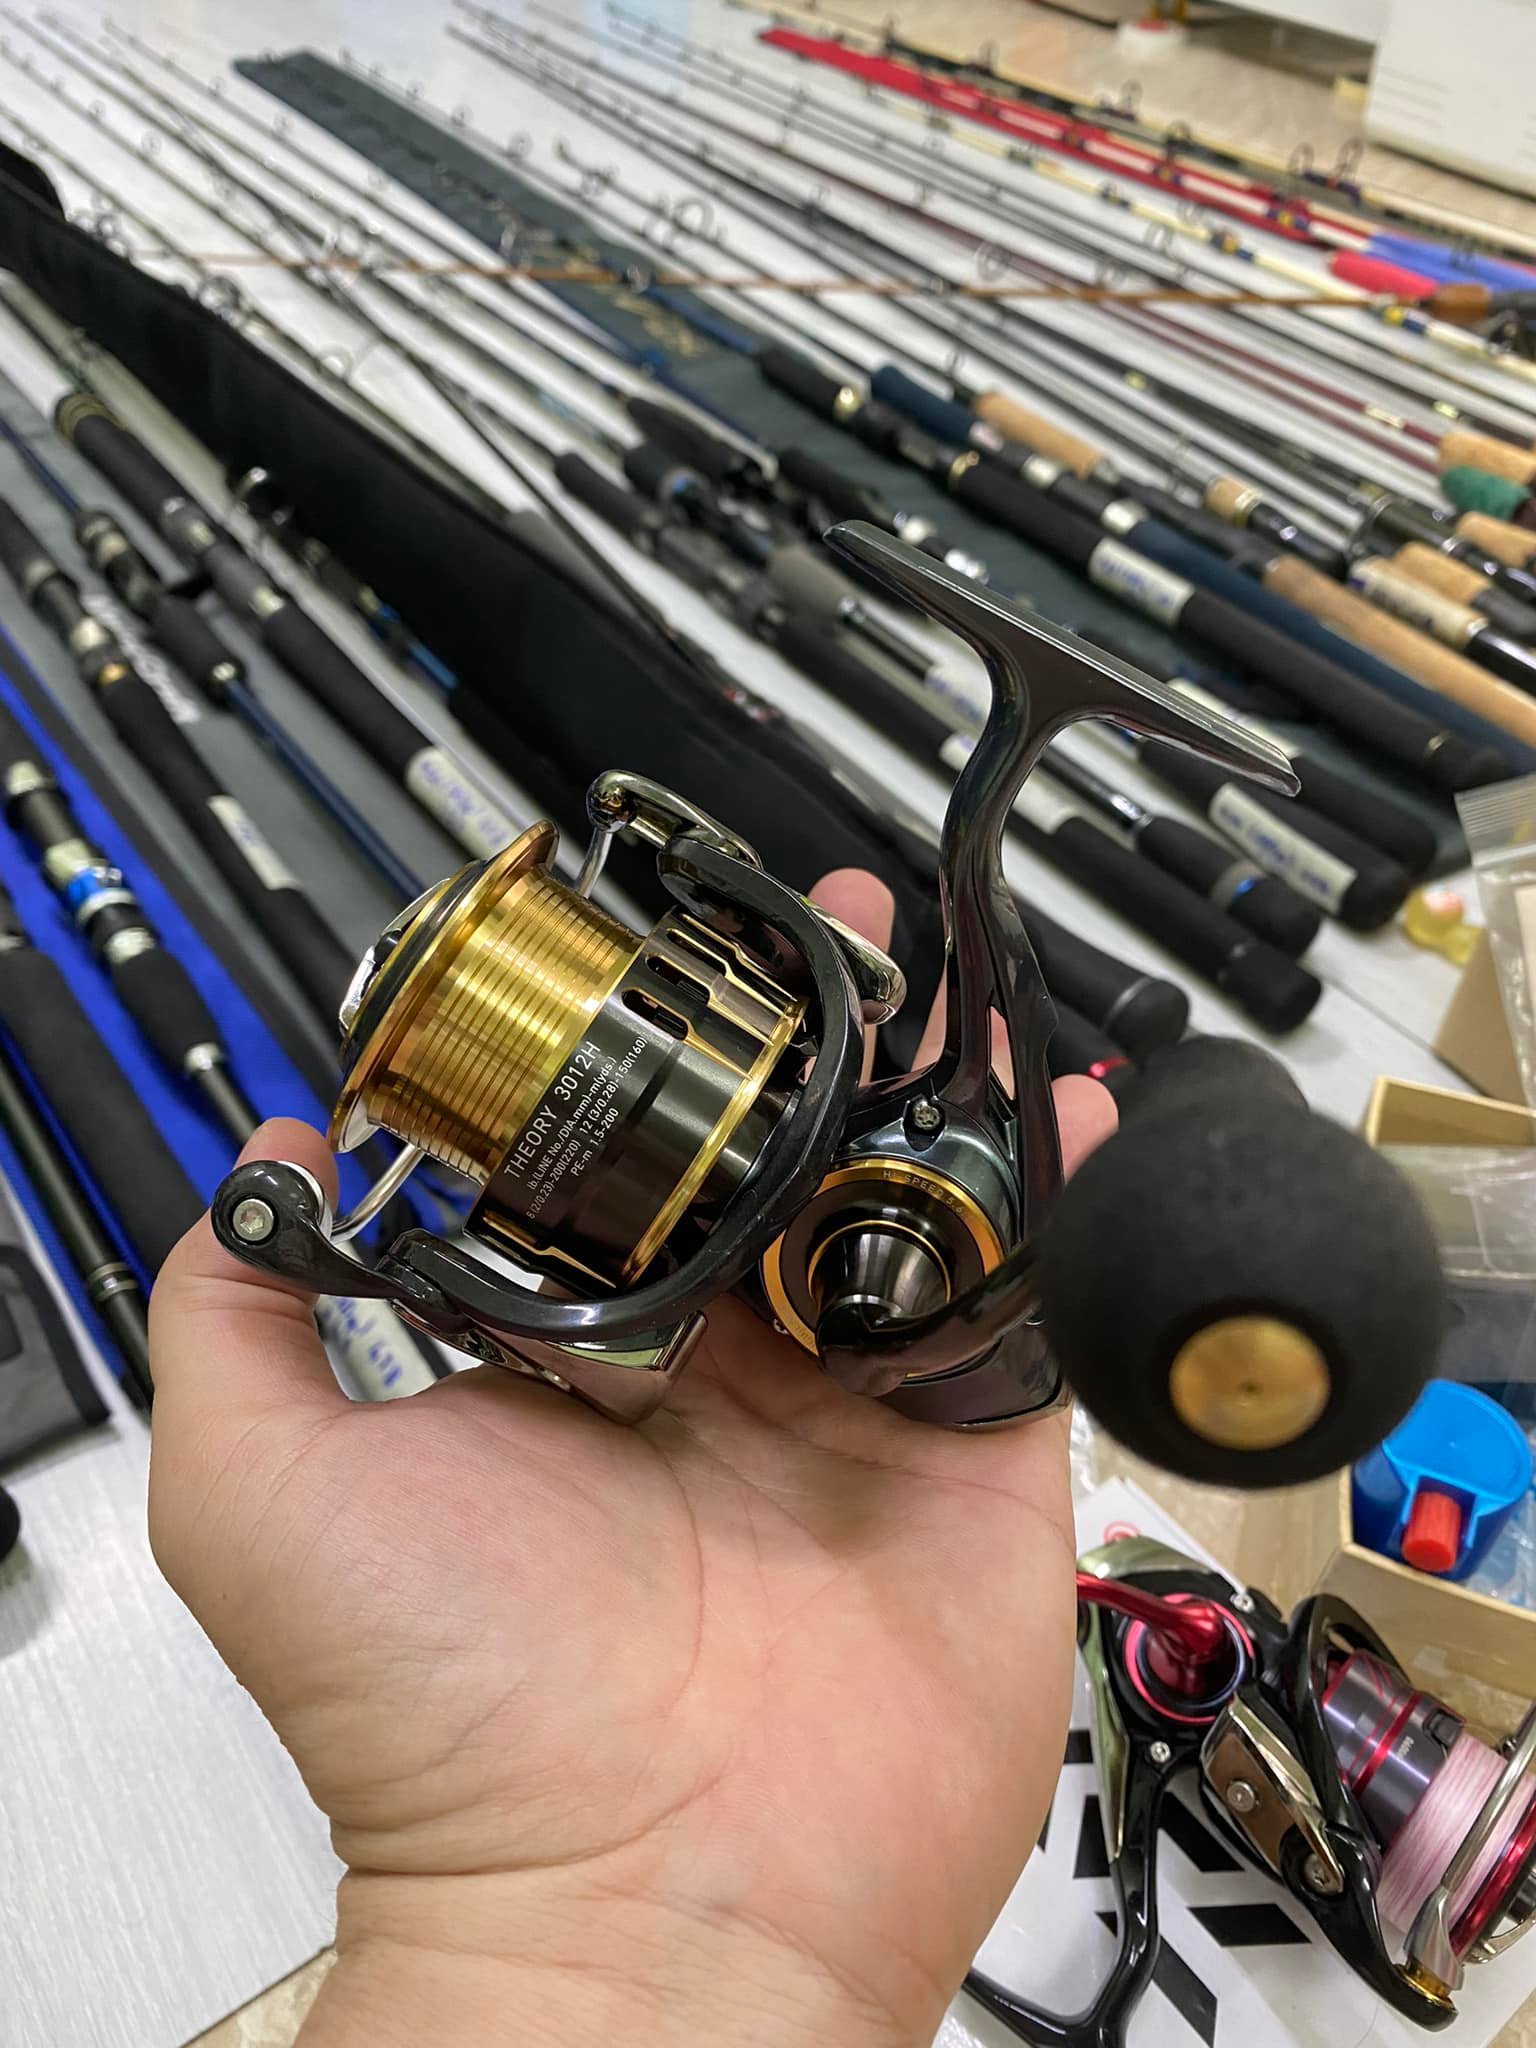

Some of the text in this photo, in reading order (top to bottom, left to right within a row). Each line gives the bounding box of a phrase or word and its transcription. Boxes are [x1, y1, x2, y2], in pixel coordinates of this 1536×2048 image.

[503, 1041, 601, 1179] THEORY 3012H
[570, 1107, 620, 1177] PE-m 1.5-200
[903, 1175, 944, 1198] SPEED
